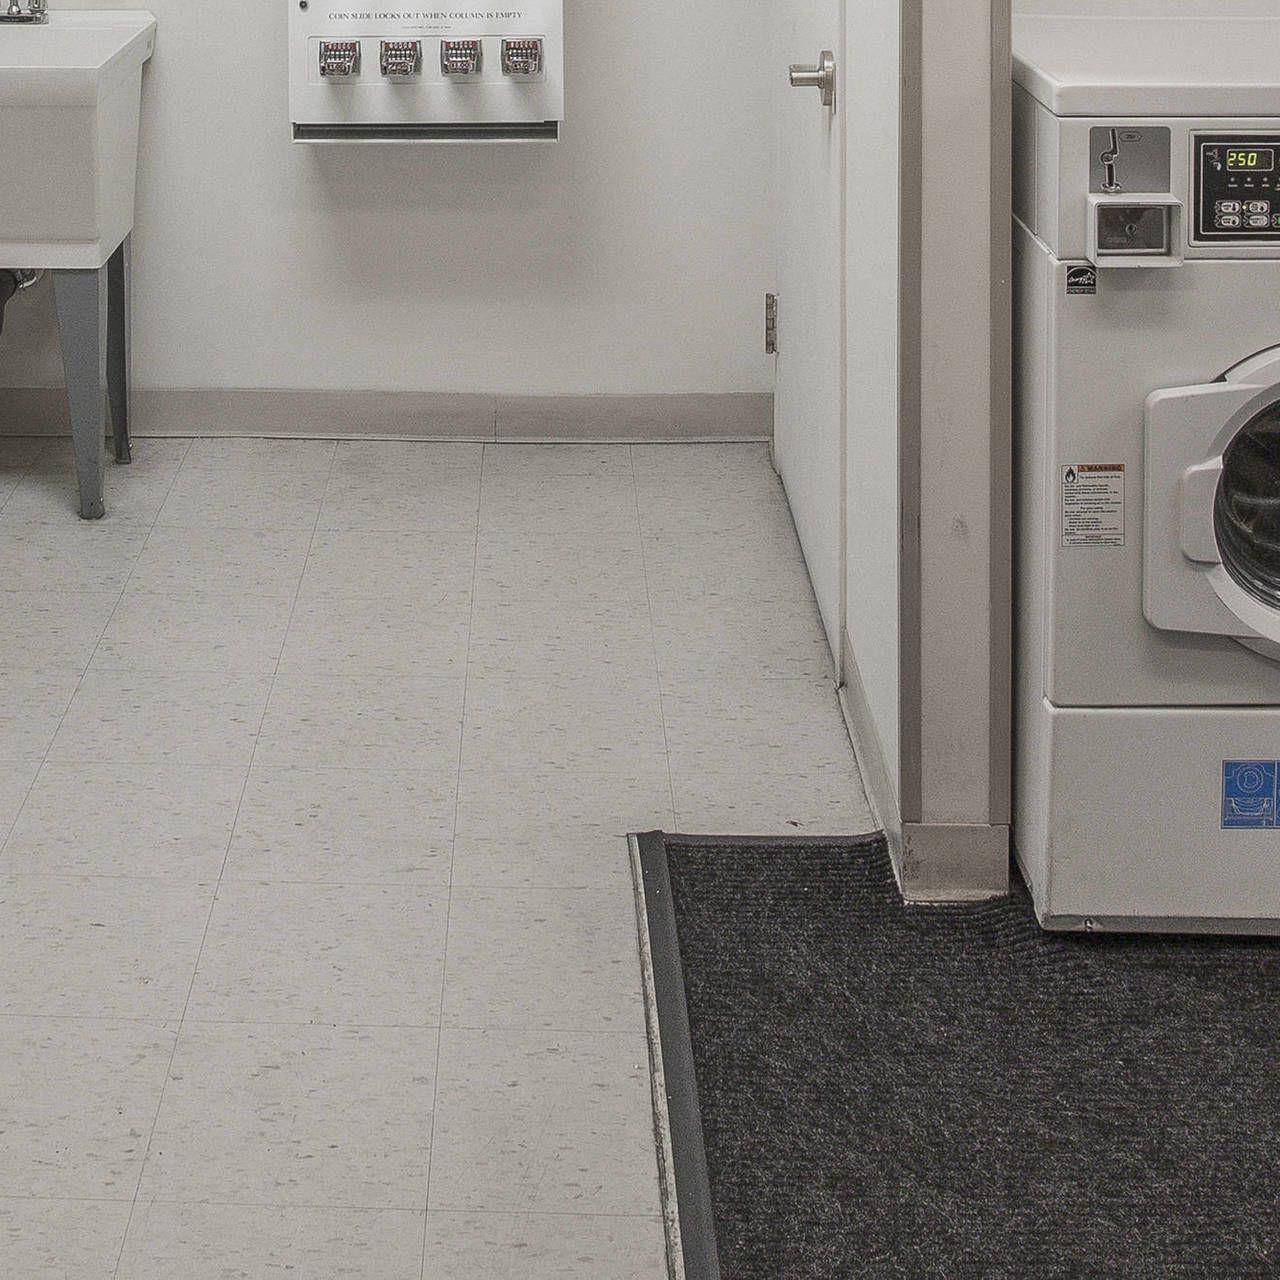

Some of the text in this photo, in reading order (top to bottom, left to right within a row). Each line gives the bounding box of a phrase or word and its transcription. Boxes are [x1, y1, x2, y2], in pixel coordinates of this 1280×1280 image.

[328, 12, 349, 20] COIN
[374, 12, 401, 20] LOCKS
[402, 12, 420, 20] OUT
[422, 12, 447, 20] WHEN
[495, 12, 523, 20] EMPTY
[1228, 152, 1258, 166] 250
